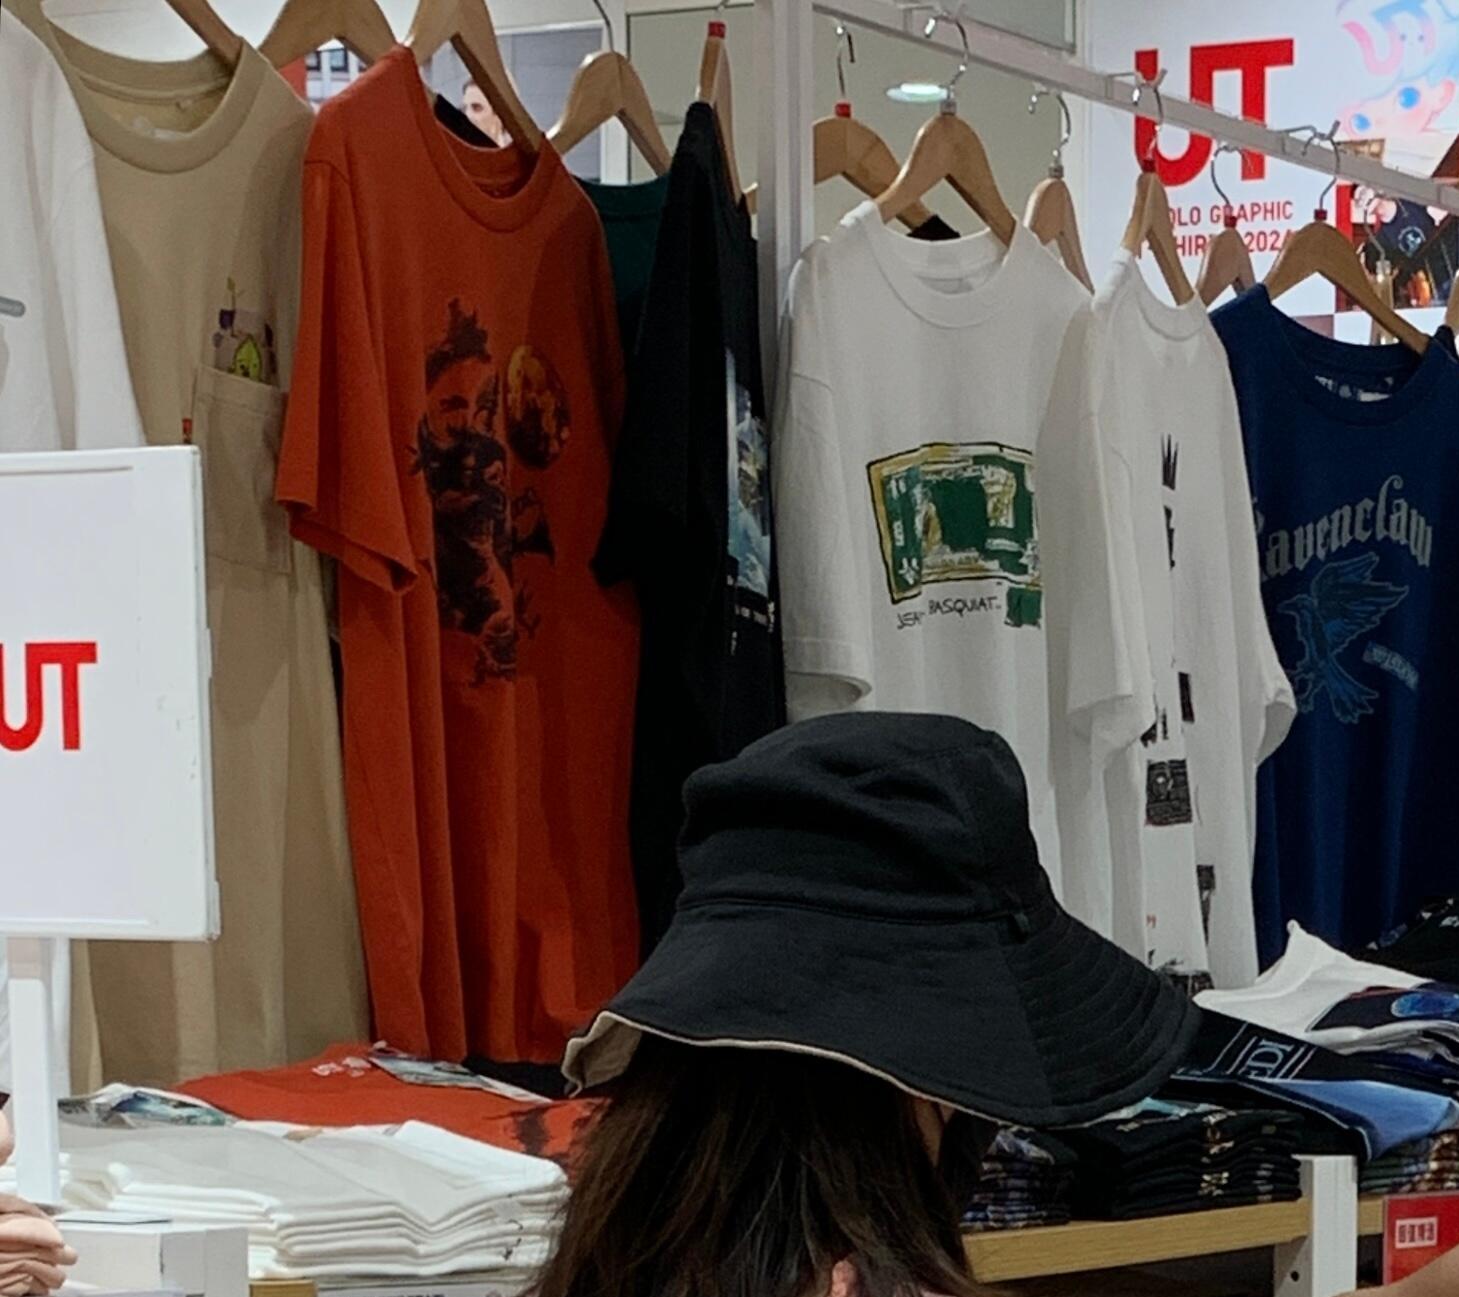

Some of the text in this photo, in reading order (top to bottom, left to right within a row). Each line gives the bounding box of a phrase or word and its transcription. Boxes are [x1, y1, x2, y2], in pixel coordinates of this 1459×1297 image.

[1134, 38, 1295, 187] UT
[1251, 474, 1433, 583] avenclaw
[0, 641, 98, 752] UT
